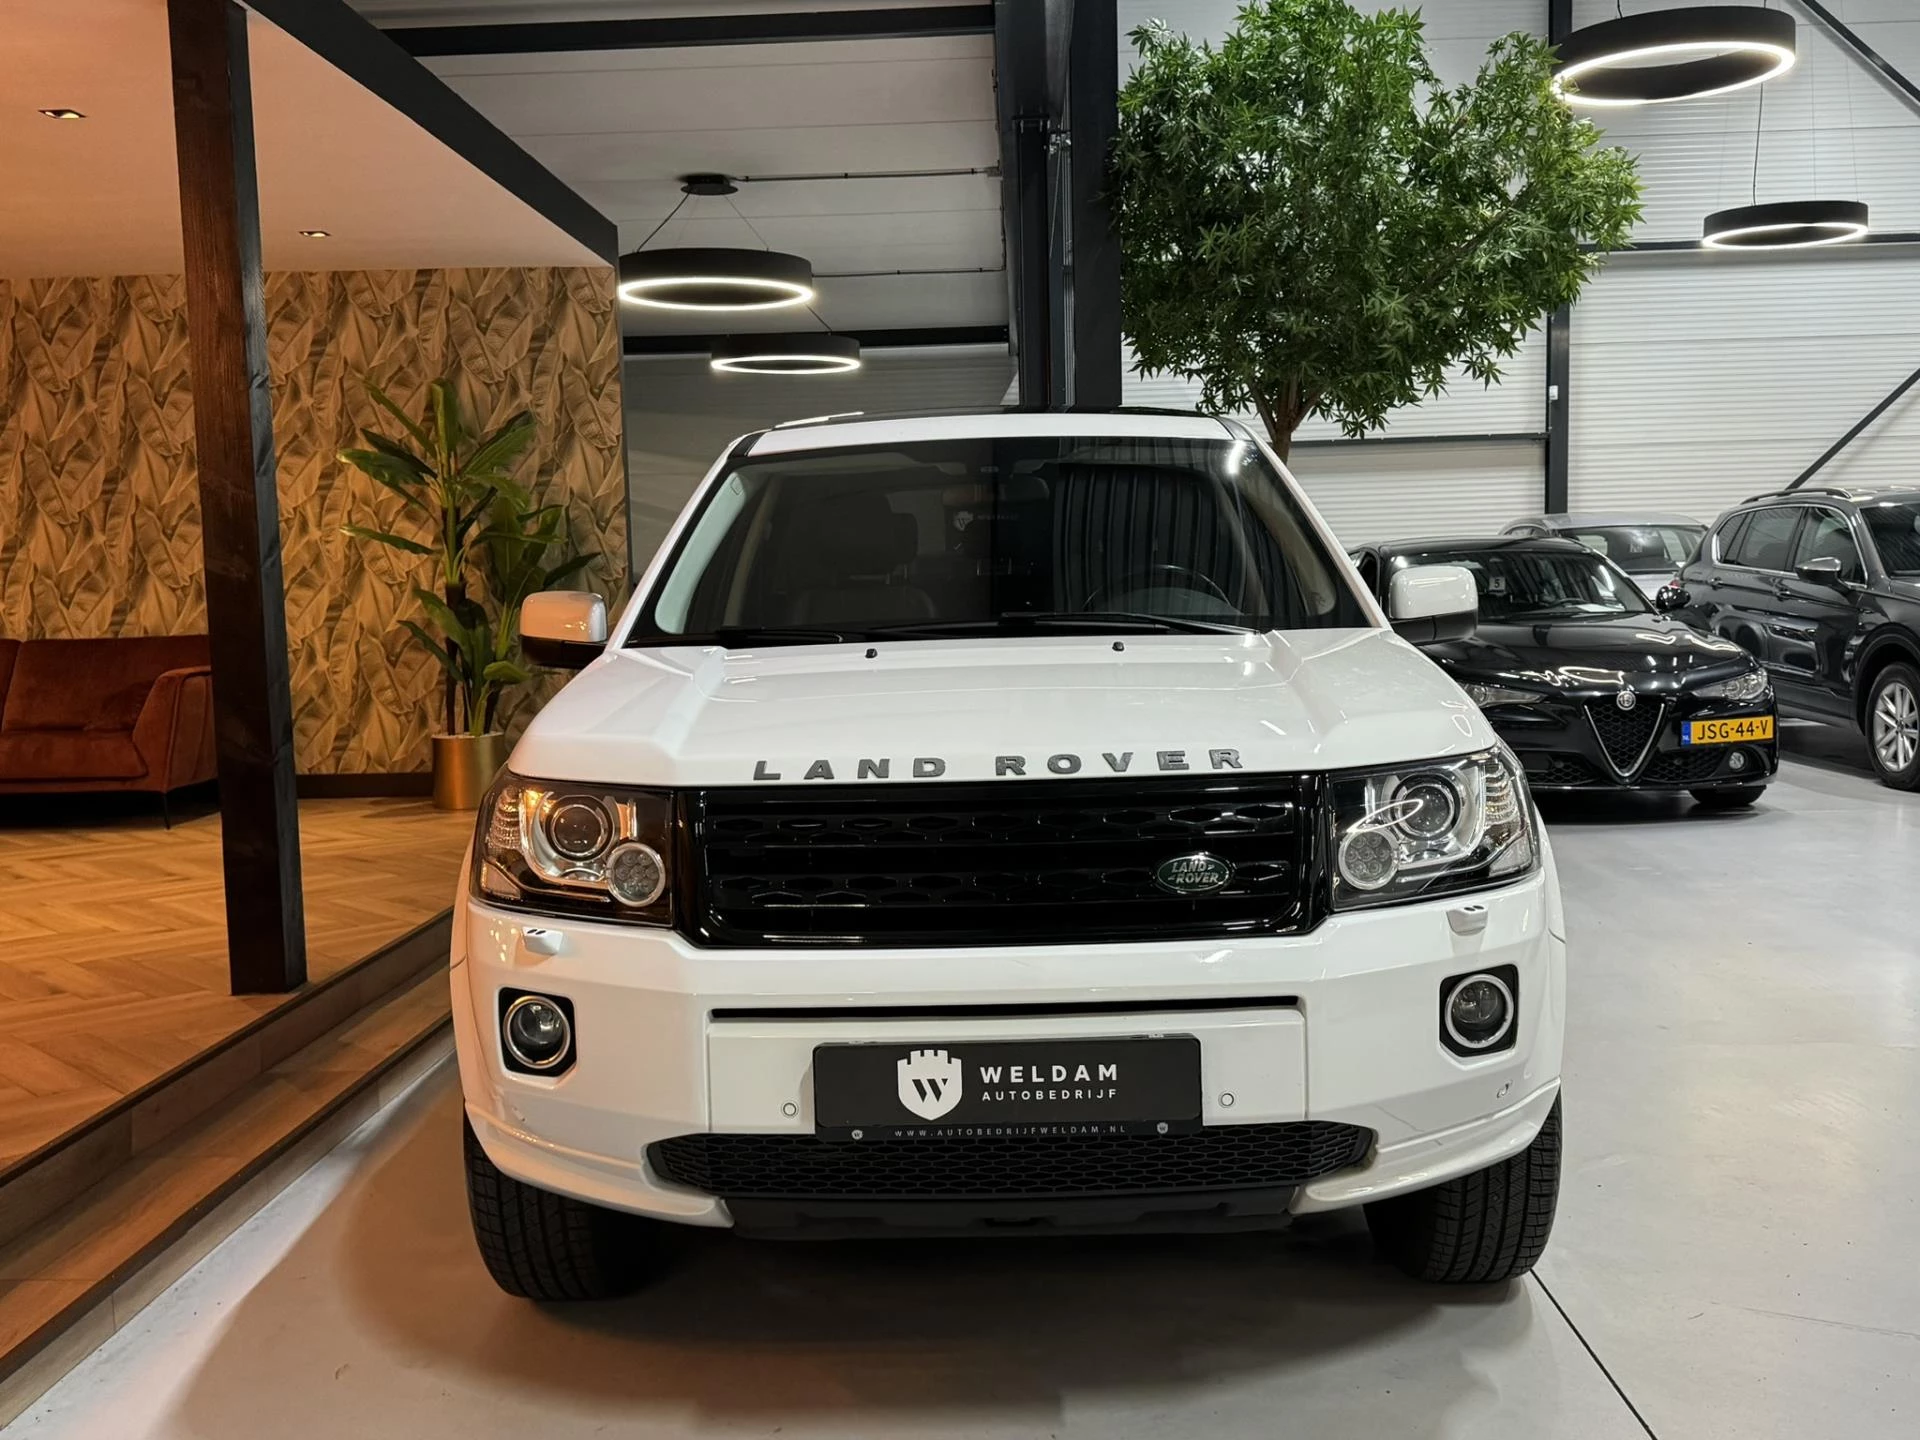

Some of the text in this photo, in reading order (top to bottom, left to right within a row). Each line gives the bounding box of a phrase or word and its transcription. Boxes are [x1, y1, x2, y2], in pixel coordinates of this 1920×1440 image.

[1697, 719, 1768, 741] JSG-44-V
[753, 748, 1243, 781] LAND ROVER
[1171, 859, 1207, 873] LAND
[1175, 872, 1219, 884] ROVER
[980, 1064, 1117, 1083] WELDAM
[982, 1088, 1117, 1101] AUTOBEDRIJF
[894, 1125, 1126, 1137] WWW.AUTOBEDRIJFWELDAM.NL
